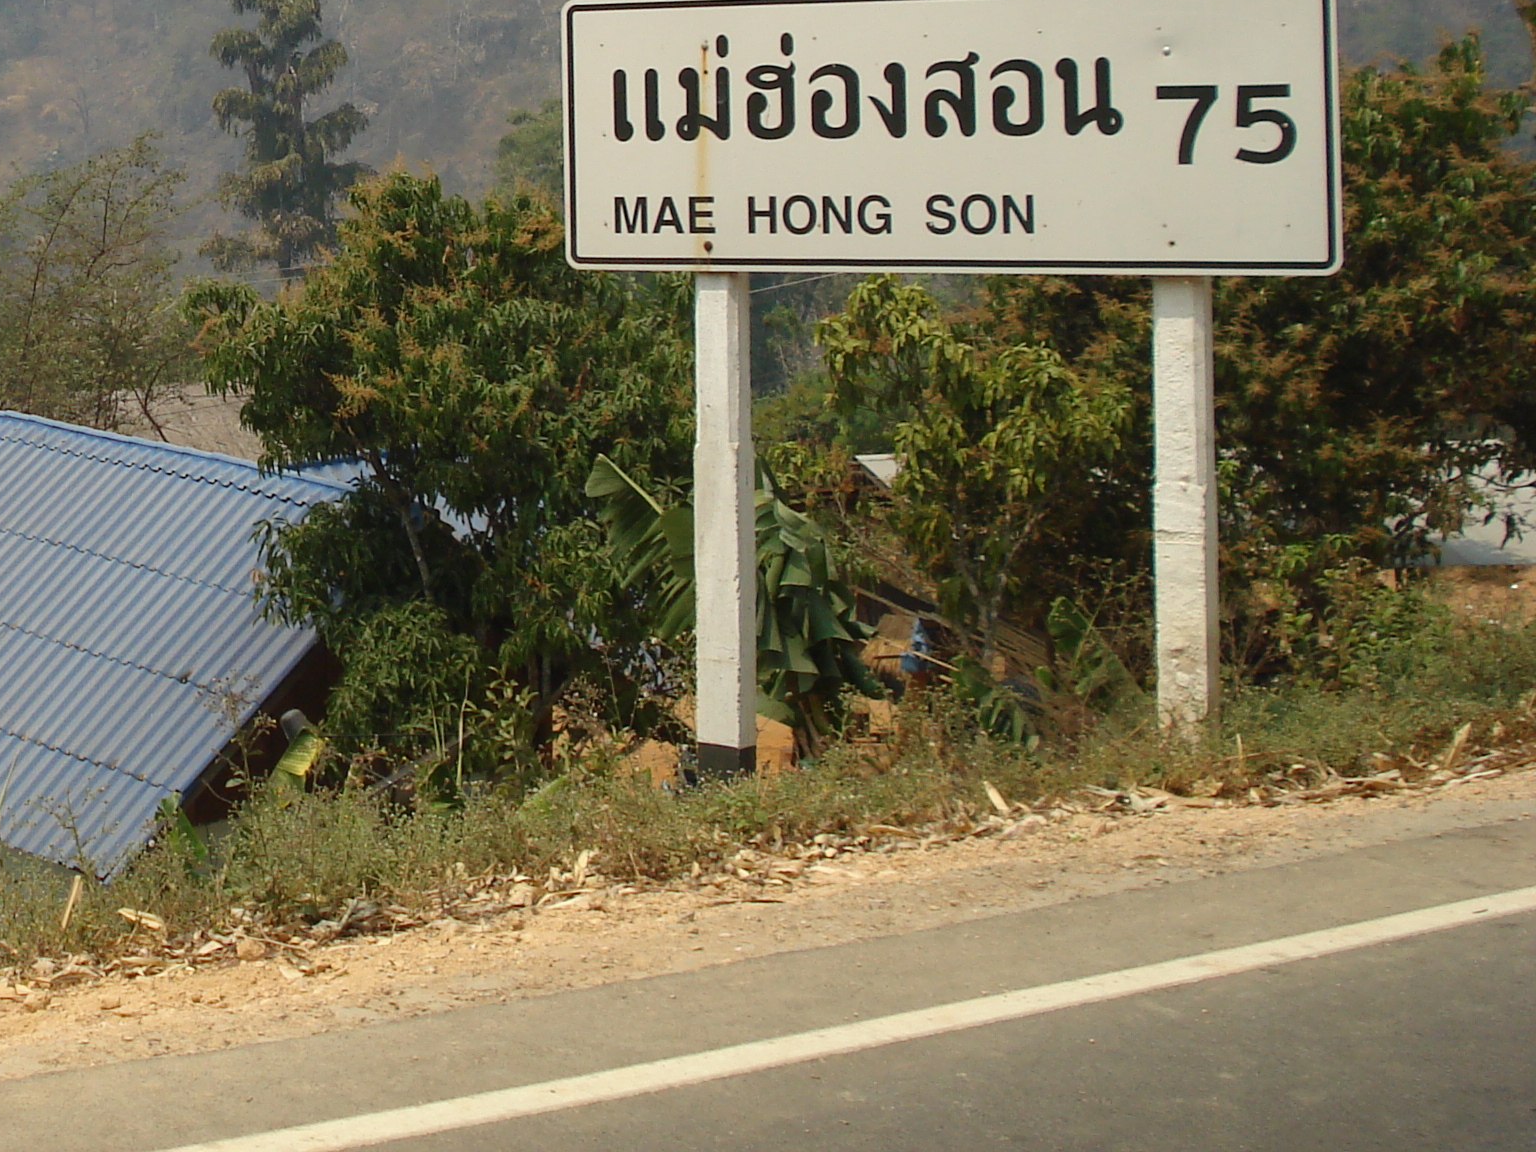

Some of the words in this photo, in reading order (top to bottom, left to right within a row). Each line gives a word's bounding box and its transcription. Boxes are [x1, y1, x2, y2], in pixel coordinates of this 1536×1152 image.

[613, 32, 1125, 142] แม่ฮ่องสอน
[1155, 83, 1297, 165] 75
[614, 196, 716, 234] MAE
[747, 194, 892, 235] HONG
[925, 193, 1035, 235] SON
